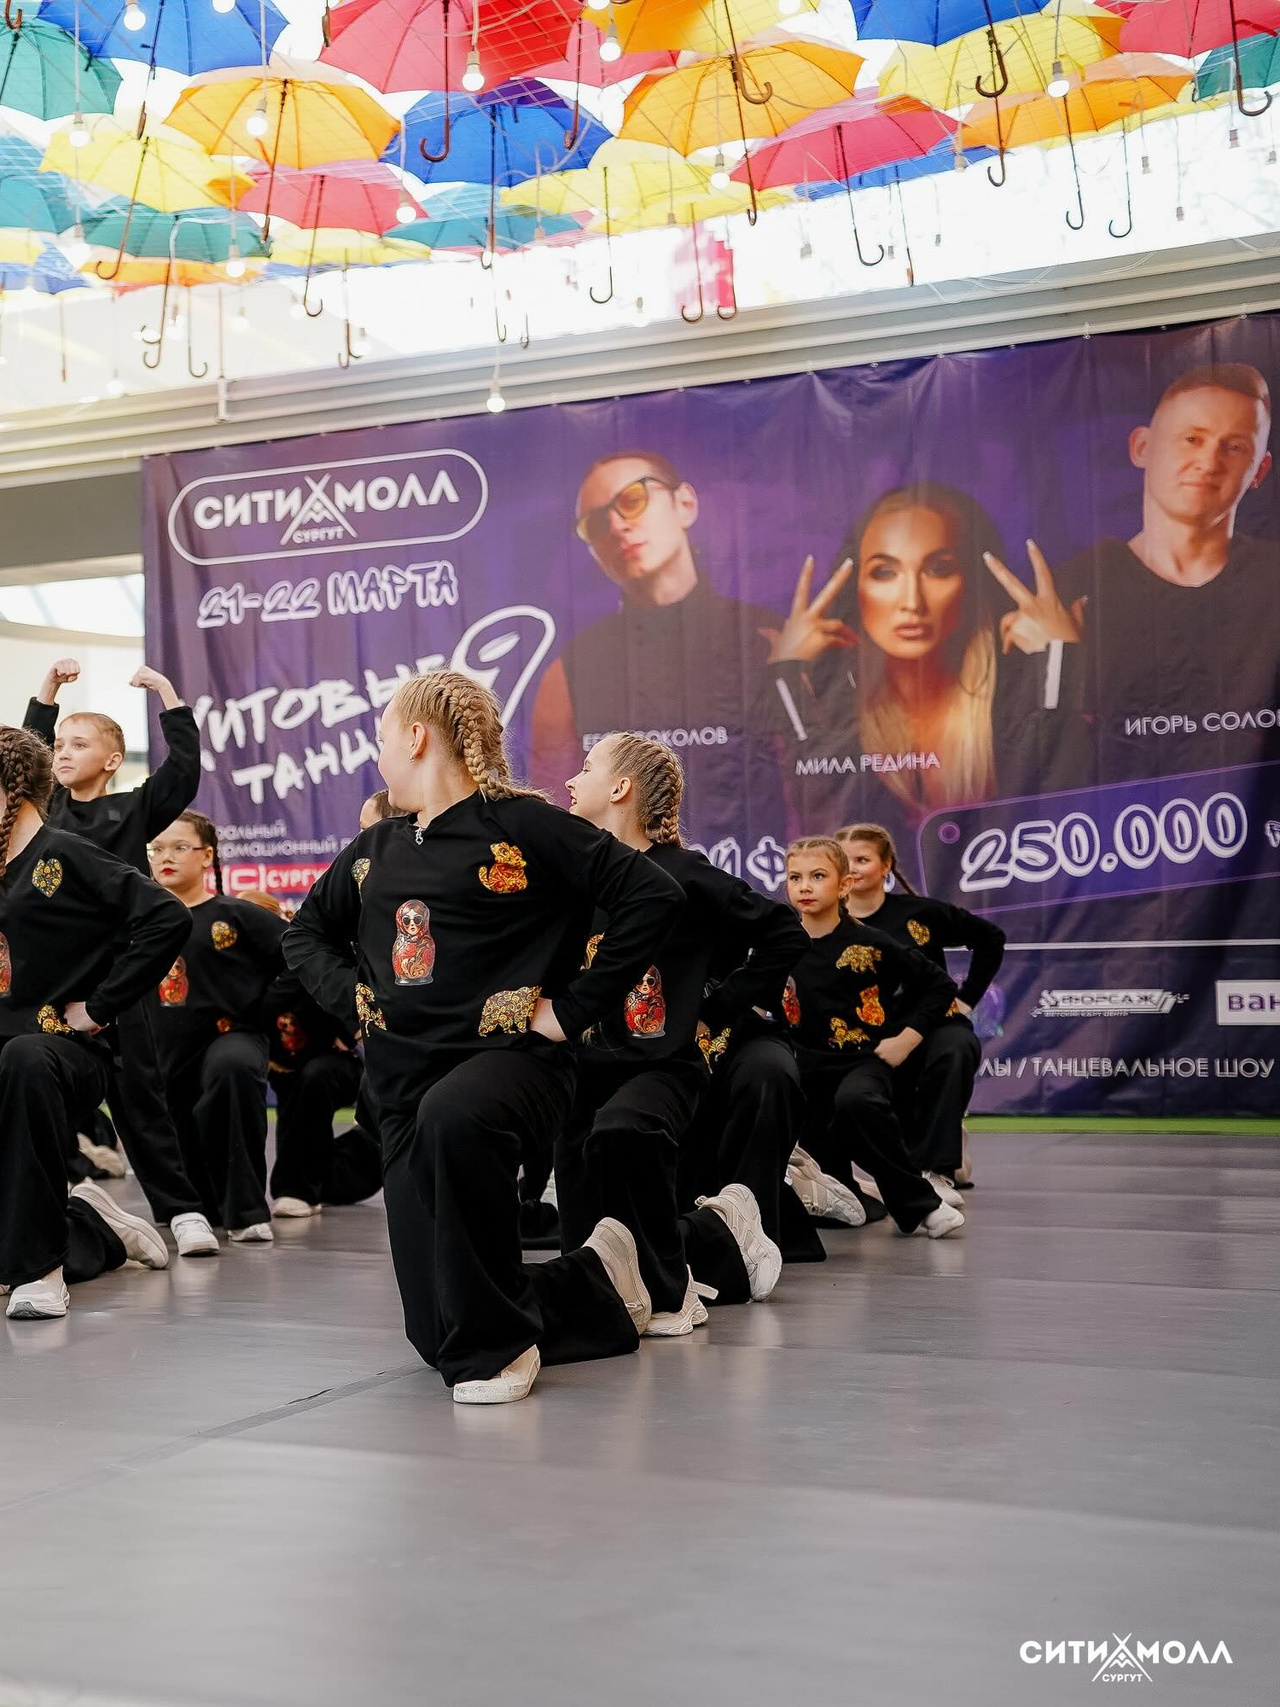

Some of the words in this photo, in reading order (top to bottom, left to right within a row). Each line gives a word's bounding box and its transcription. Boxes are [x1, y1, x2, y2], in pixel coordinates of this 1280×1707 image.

[292, 525, 345, 543] СУРГУТ
[196, 577, 322, 629] 21-22
[326, 559, 459, 616] МАРТА
[1124, 714, 1198, 737] ИГОРЬ
[1202, 708, 1280, 733] СОЛО
[633, 725, 729, 748] ОКОЛОВ
[231, 716, 381, 805] ТАНЦ
[795, 756, 857, 776] МИЛА
[859, 751, 941, 773] РЕДИНА
[959, 791, 1248, 893] 250.000
[267, 868, 326, 888] СУРГУ
[1030, 1056, 1209, 1079] ТАНЦЕВАЛЬНОЕ
[1215, 1057, 1276, 1078] ШОУ
